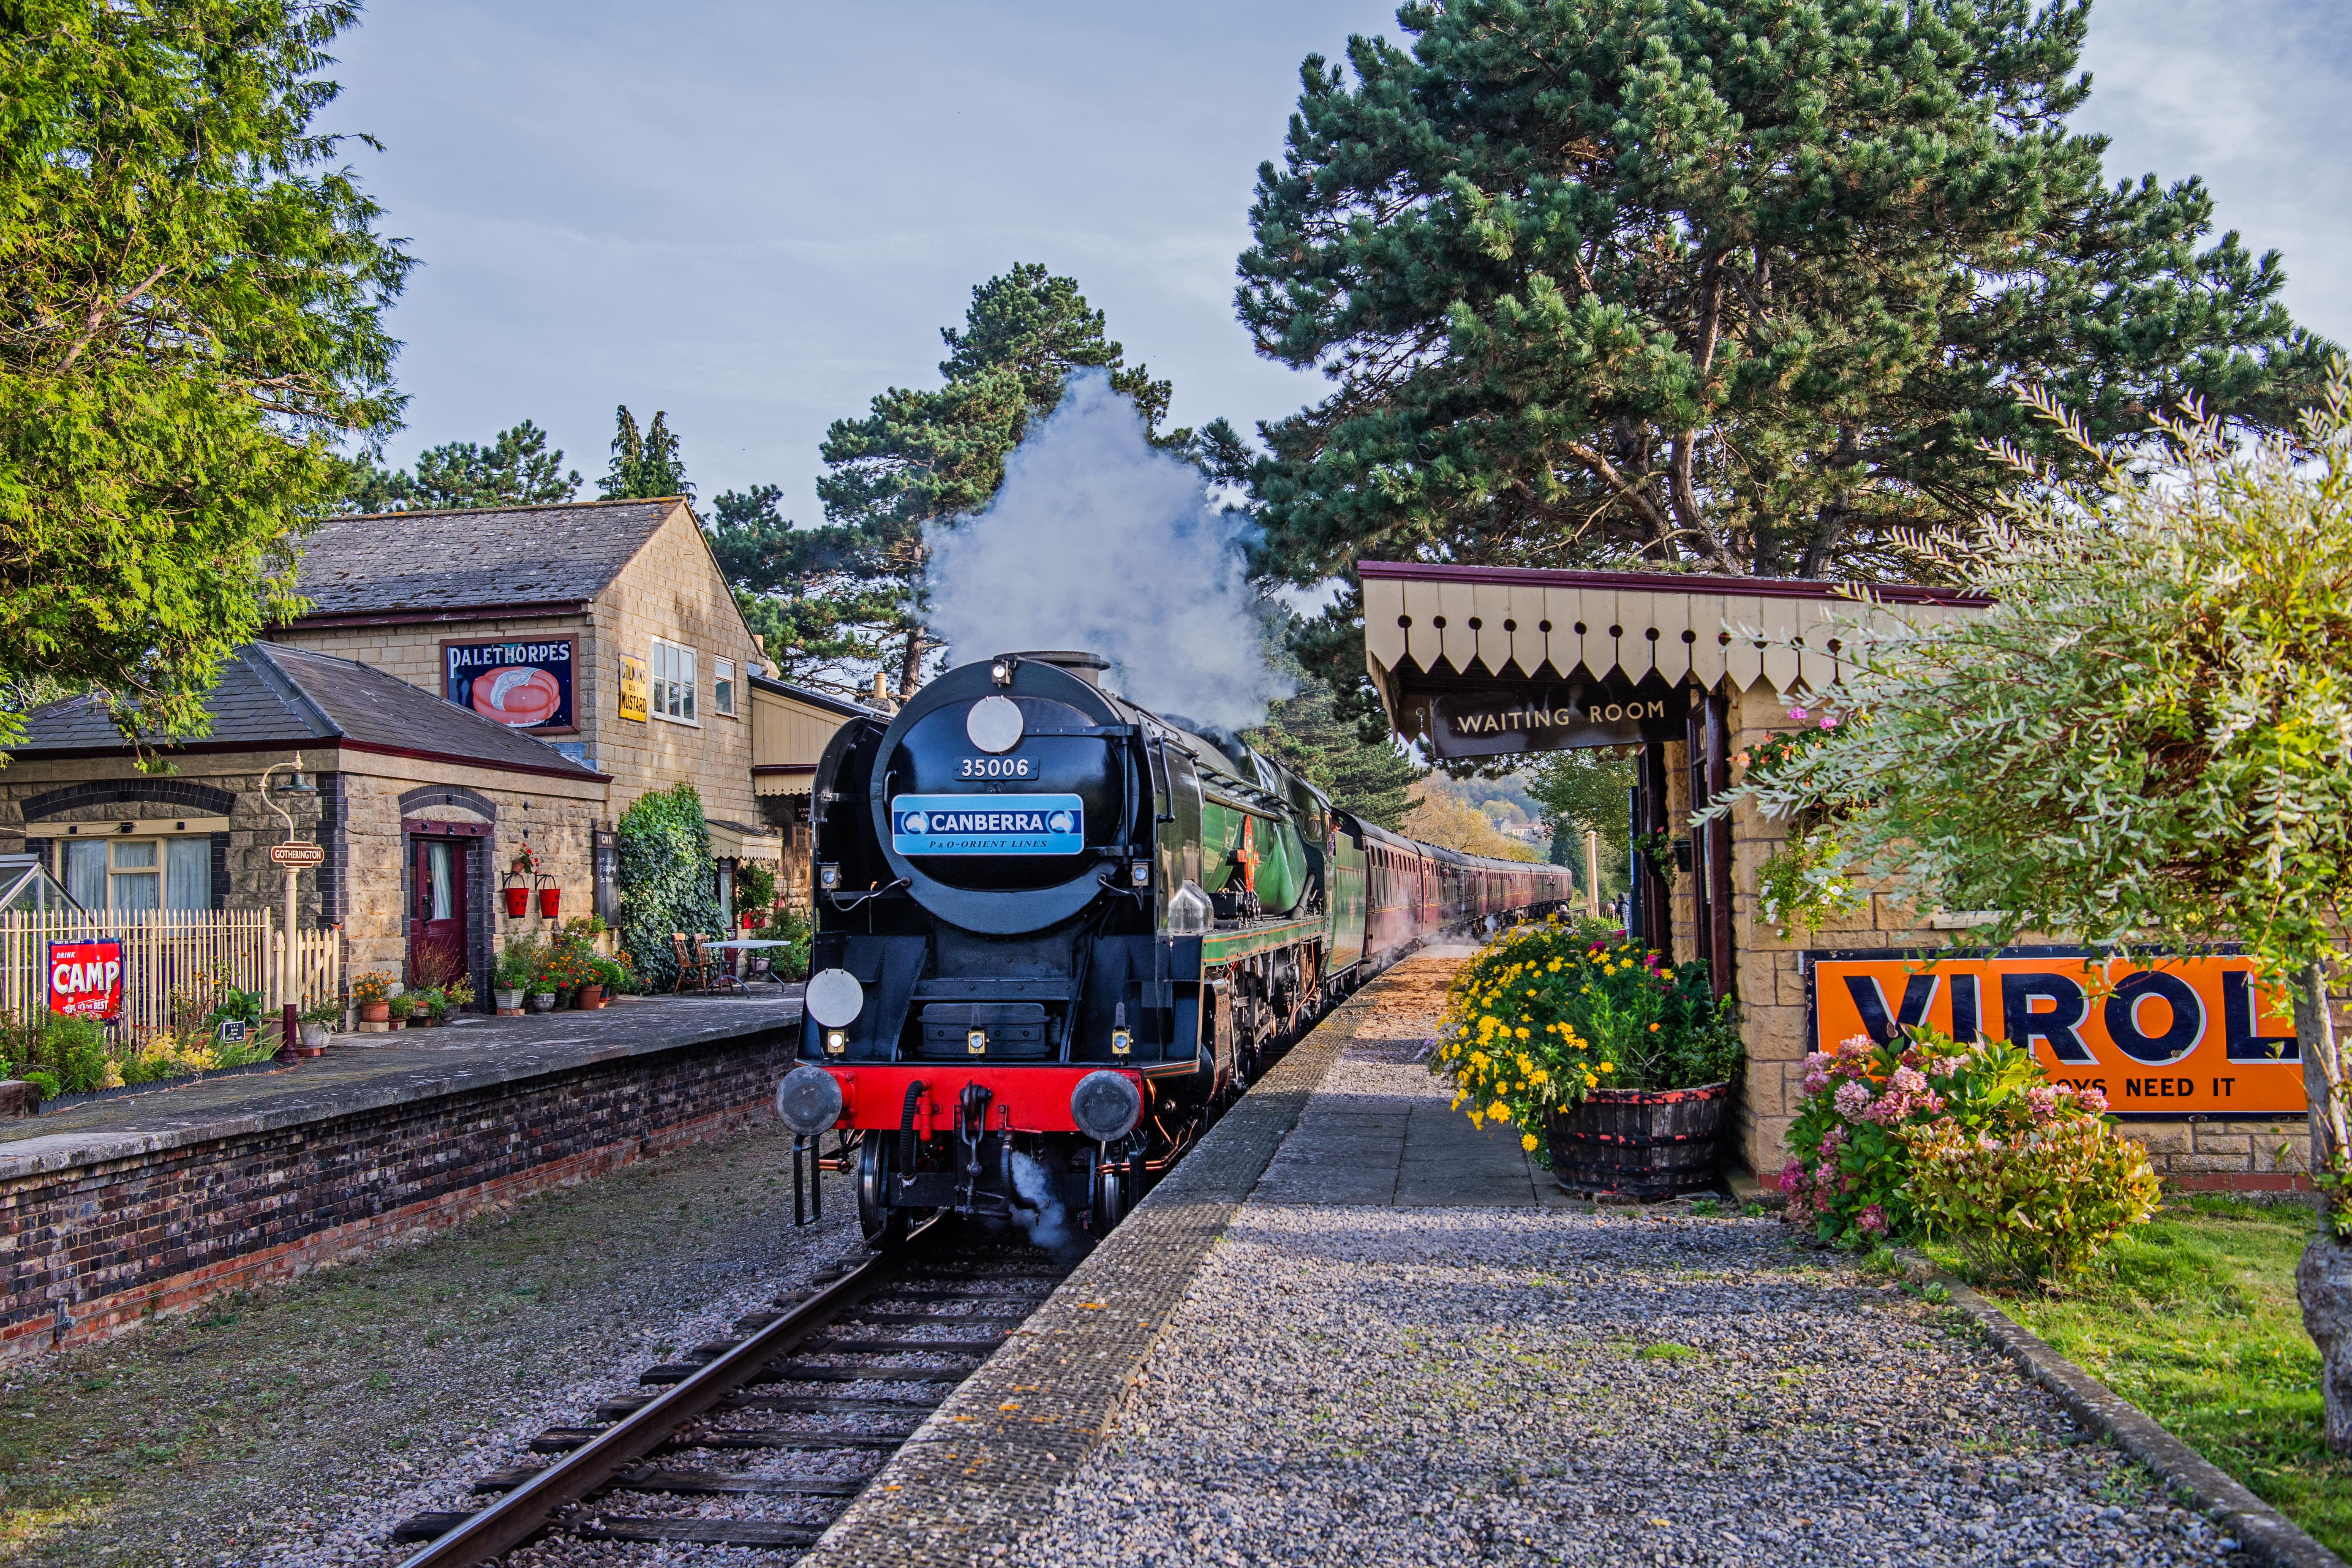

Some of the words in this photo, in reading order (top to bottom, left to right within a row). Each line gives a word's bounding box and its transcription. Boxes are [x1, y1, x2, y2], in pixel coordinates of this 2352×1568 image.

[621, 691, 646, 713] MUSTARD
[1457, 708, 1569, 733] WAITING
[1590, 700, 1664, 723] ROOM
[961, 759, 1029, 777] 35006
[931, 814, 1044, 831] CANBERRA
[601, 836, 612, 844] GWR
[275, 849, 321, 859] GOTHERINGTON
[93, 1000, 109, 1010] BEST
[1843, 969, 2303, 1066] VIROL
[2049, 1078, 2107, 1096] OYS
[2126, 1078, 2194, 1097] NEED
[2213, 1078, 2235, 1097] IT
